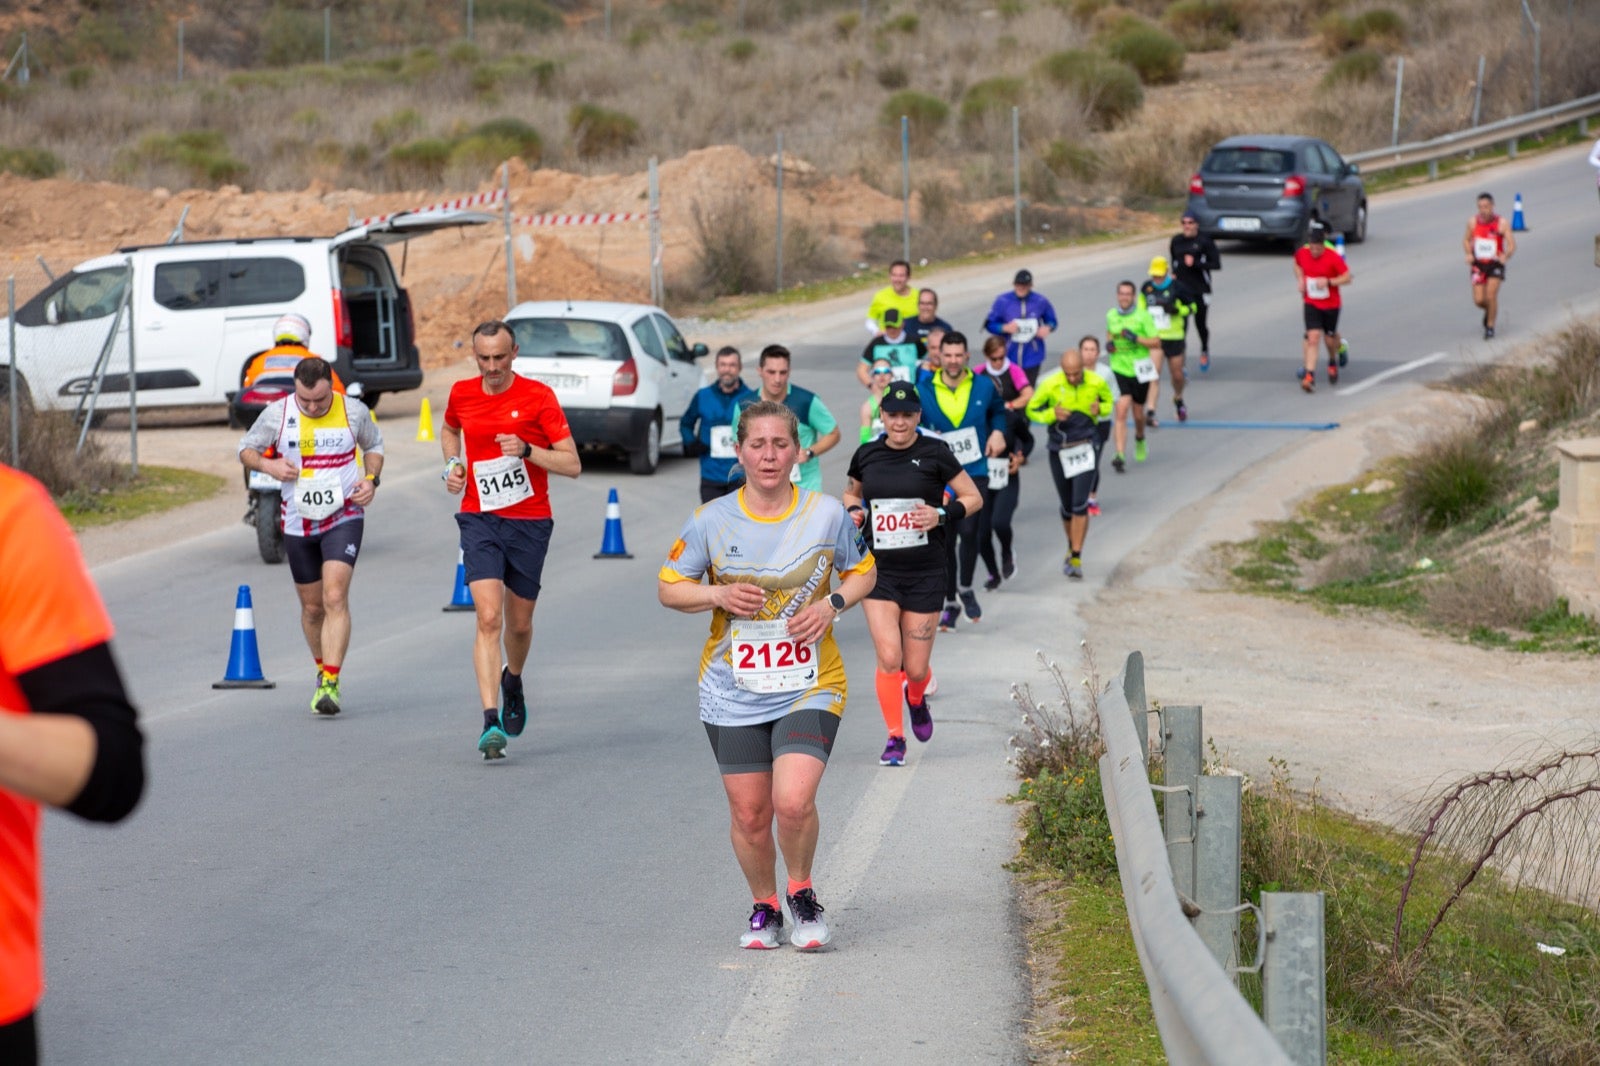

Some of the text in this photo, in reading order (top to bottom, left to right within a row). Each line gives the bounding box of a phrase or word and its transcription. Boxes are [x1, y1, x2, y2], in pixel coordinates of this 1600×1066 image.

[480, 468, 525, 495] 3145
[302, 490, 334, 505] 403
[780, 555, 827, 619] NNING
[737, 639, 812, 669] 2126
